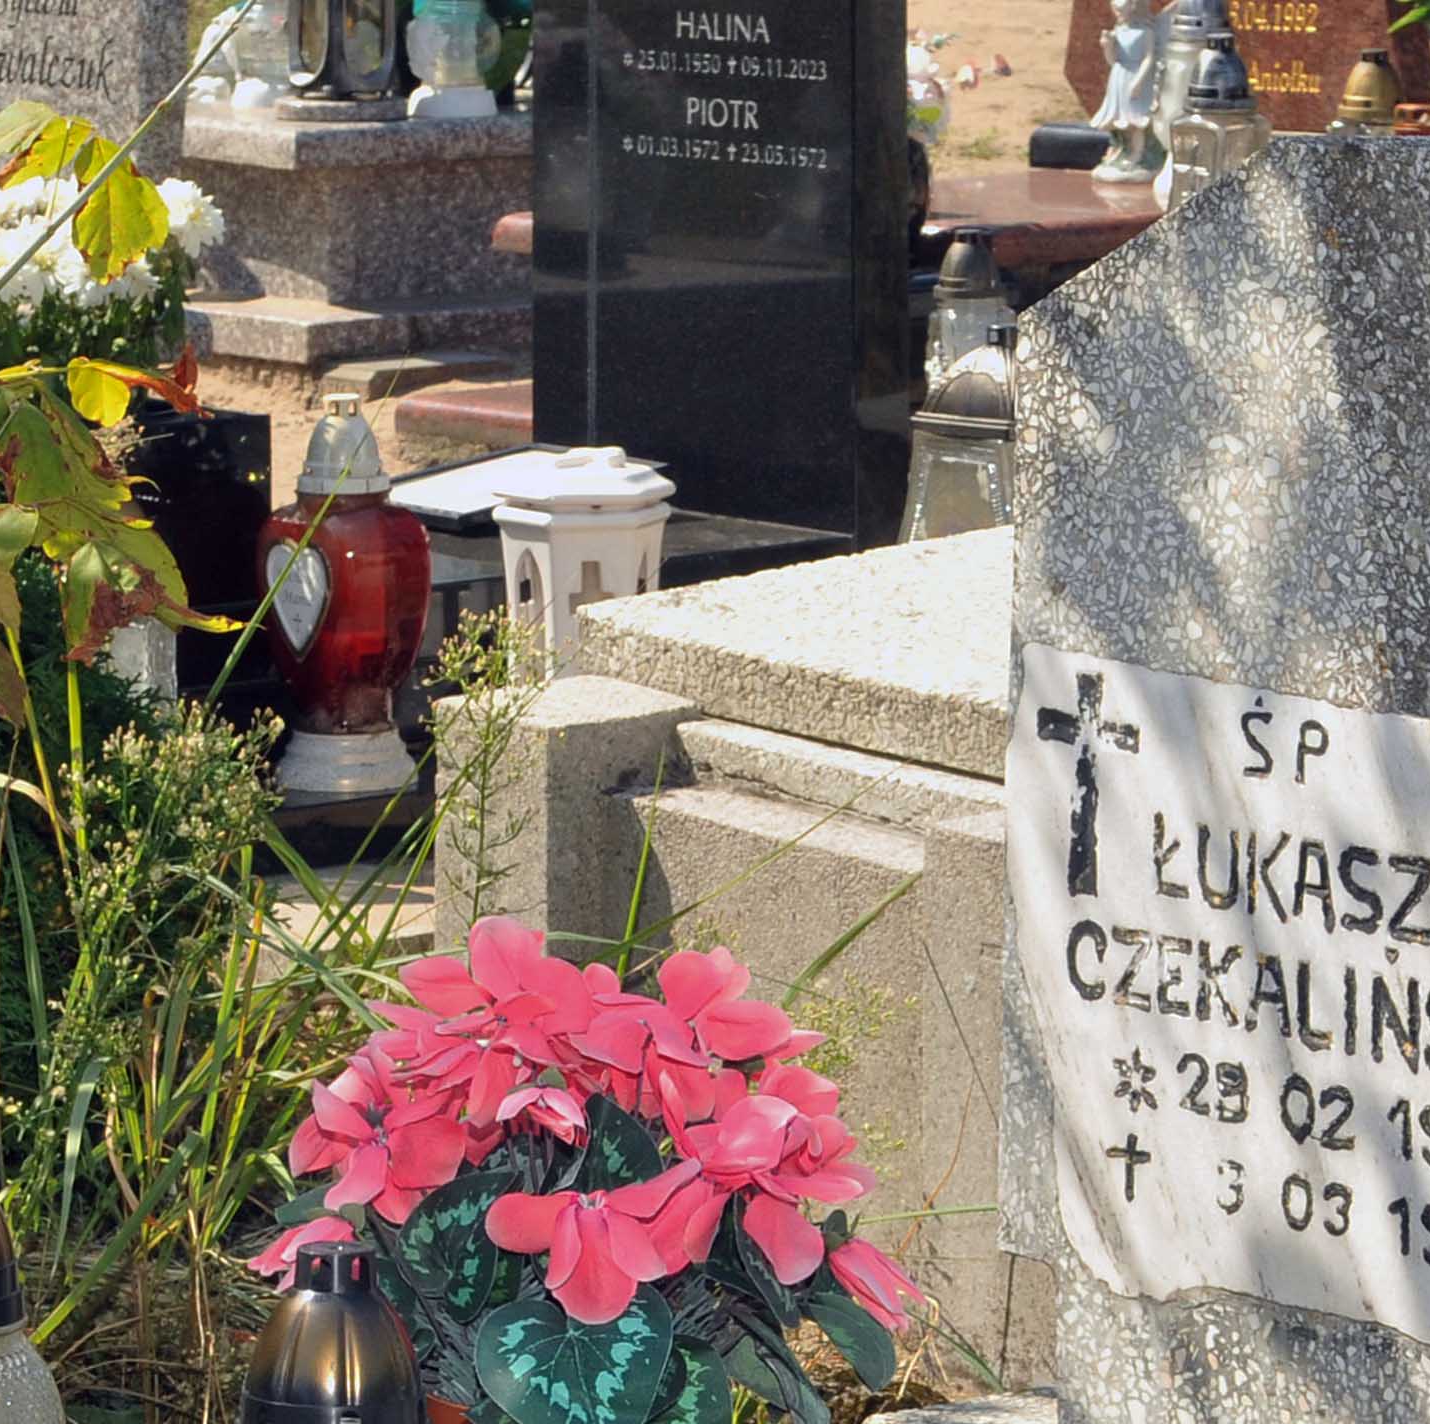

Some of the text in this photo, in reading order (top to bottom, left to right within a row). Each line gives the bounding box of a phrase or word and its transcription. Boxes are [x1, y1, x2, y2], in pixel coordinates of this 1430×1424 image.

[675, 10, 771, 44] HALINA
[637, 49, 828, 81] 25.01.1950 09.11.2023
[685, 96, 759, 130] PIOTR
[1280, 1072, 1356, 1152] 02
[1216, 1158, 1246, 1216] 3
[1281, 1172, 1354, 1238] 03
